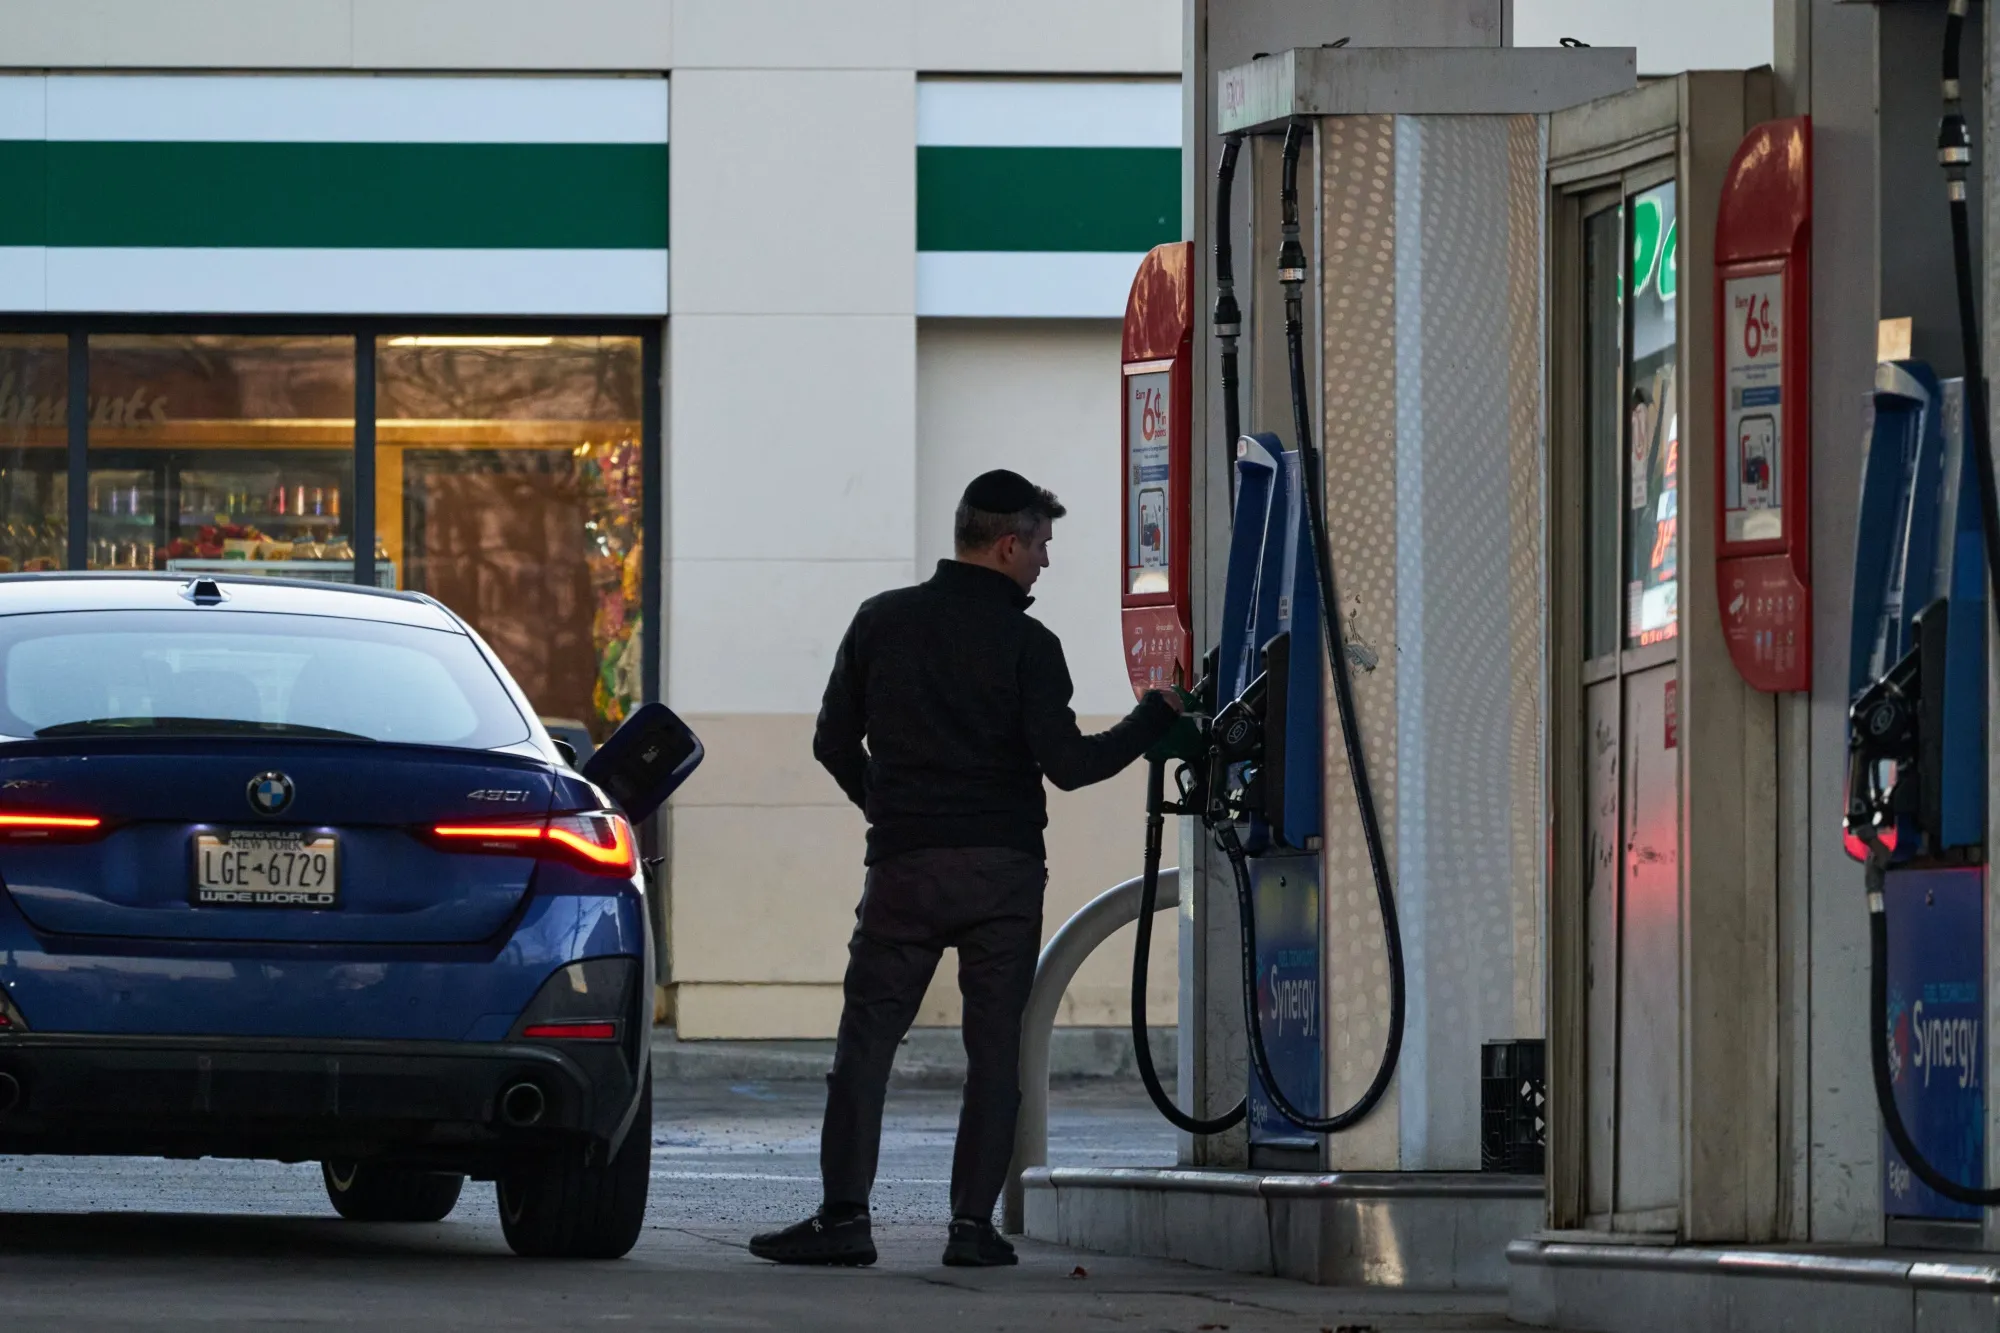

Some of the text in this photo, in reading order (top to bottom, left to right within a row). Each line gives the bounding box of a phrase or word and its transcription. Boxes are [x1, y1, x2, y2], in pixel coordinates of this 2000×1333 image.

[231, 839, 302, 852] NEW YORK
[266, 832, 301, 841] VALLEY
[206, 850, 327, 887] LGE 6729
[201, 890, 334, 904] WIDE WORLD
[1271, 964, 1316, 1037] Synergy
[1913, 1000, 1978, 1088] Synergy
